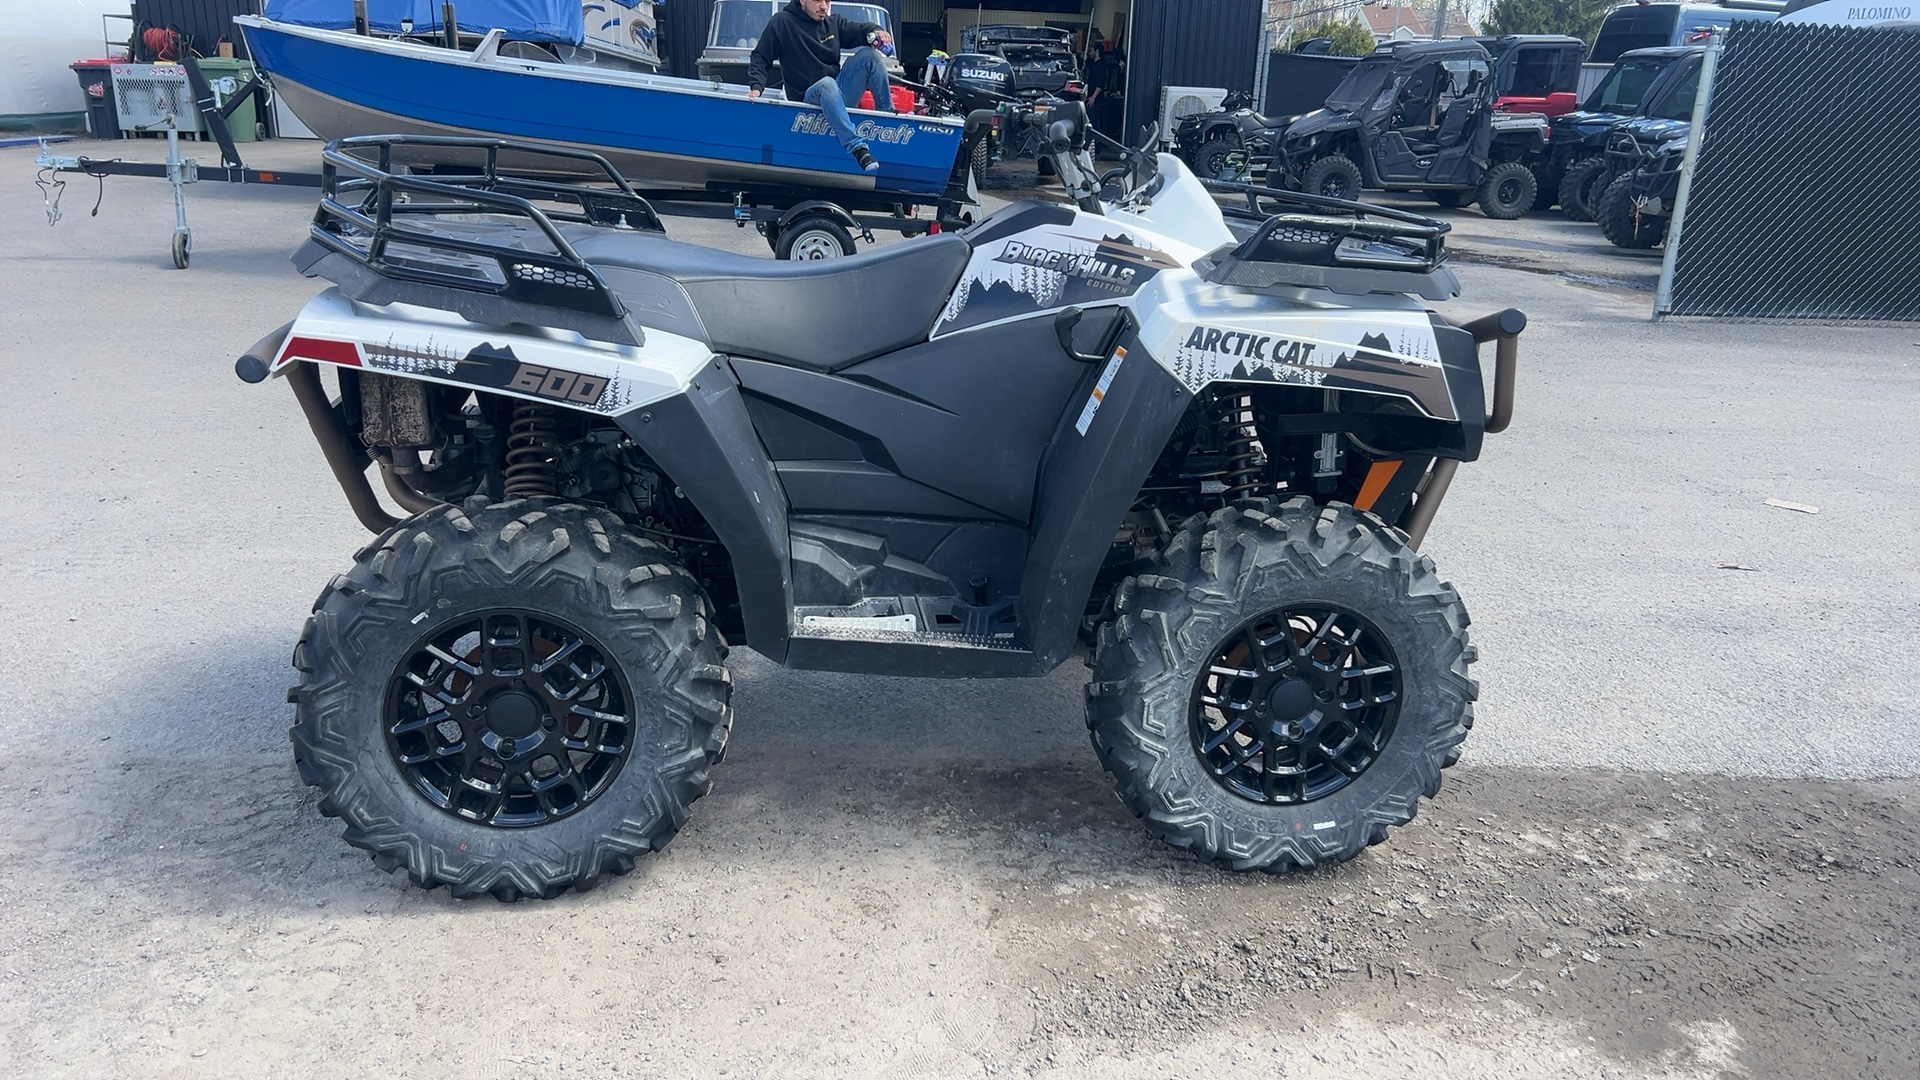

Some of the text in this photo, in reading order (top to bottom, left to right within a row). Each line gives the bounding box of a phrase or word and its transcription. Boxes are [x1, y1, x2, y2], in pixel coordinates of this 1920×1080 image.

[1847, 6, 1911, 20] PALOMINO
[961, 68, 1005, 81] SUZUKI
[791, 112, 916, 145] Mir Craft
[1086, 279, 1129, 294] EDITION
[1184, 326, 1317, 365] ARCTIC CAT
[503, 363, 609, 404] 600
